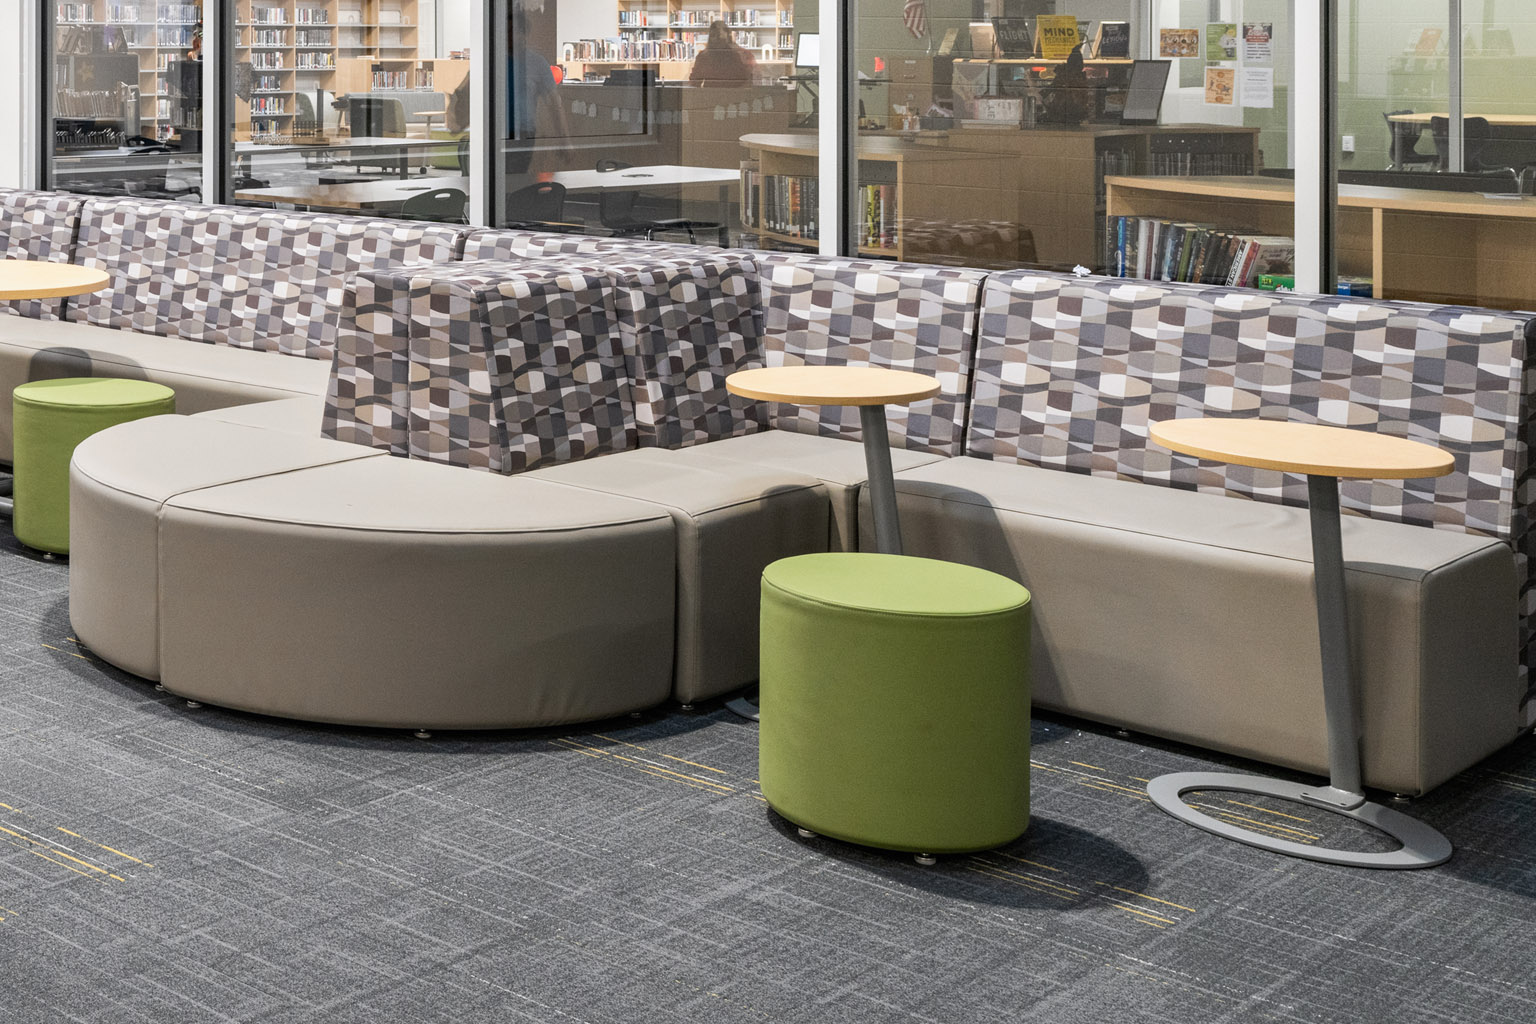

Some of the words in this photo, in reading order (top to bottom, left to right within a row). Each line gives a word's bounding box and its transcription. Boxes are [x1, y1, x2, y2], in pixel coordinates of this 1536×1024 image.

[999, 30, 1028, 40] FLIGHT
[1044, 28, 1074, 36] MIND
[1230, 249, 1243, 279] AMERICAN
